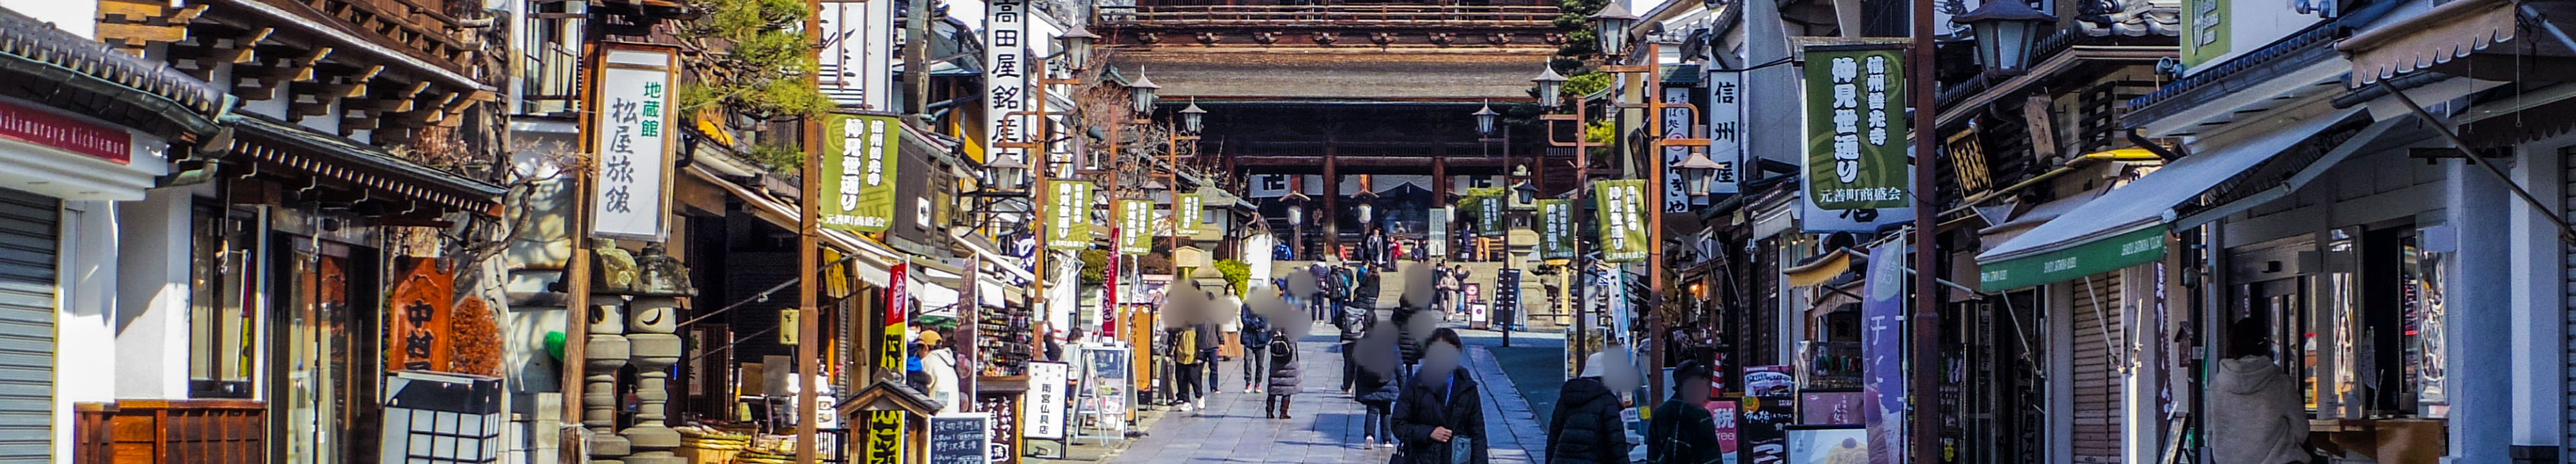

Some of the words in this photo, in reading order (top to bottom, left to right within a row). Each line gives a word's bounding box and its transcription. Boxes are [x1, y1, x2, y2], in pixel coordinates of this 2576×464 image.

[641, 82, 661, 138] 地蔵館
[1831, 57, 1860, 184] 仲見世通り
[1866, 56, 1887, 146] 信州善光寺
[1715, 81, 1735, 184] 信州屋
[1819, 187, 1901, 202] 元善町商盛会
[1000, 396, 1012, 441] とんかつと
[1039, 384, 1052, 434] 雨宮仏具店
[1716, 432, 1735, 441] ree
